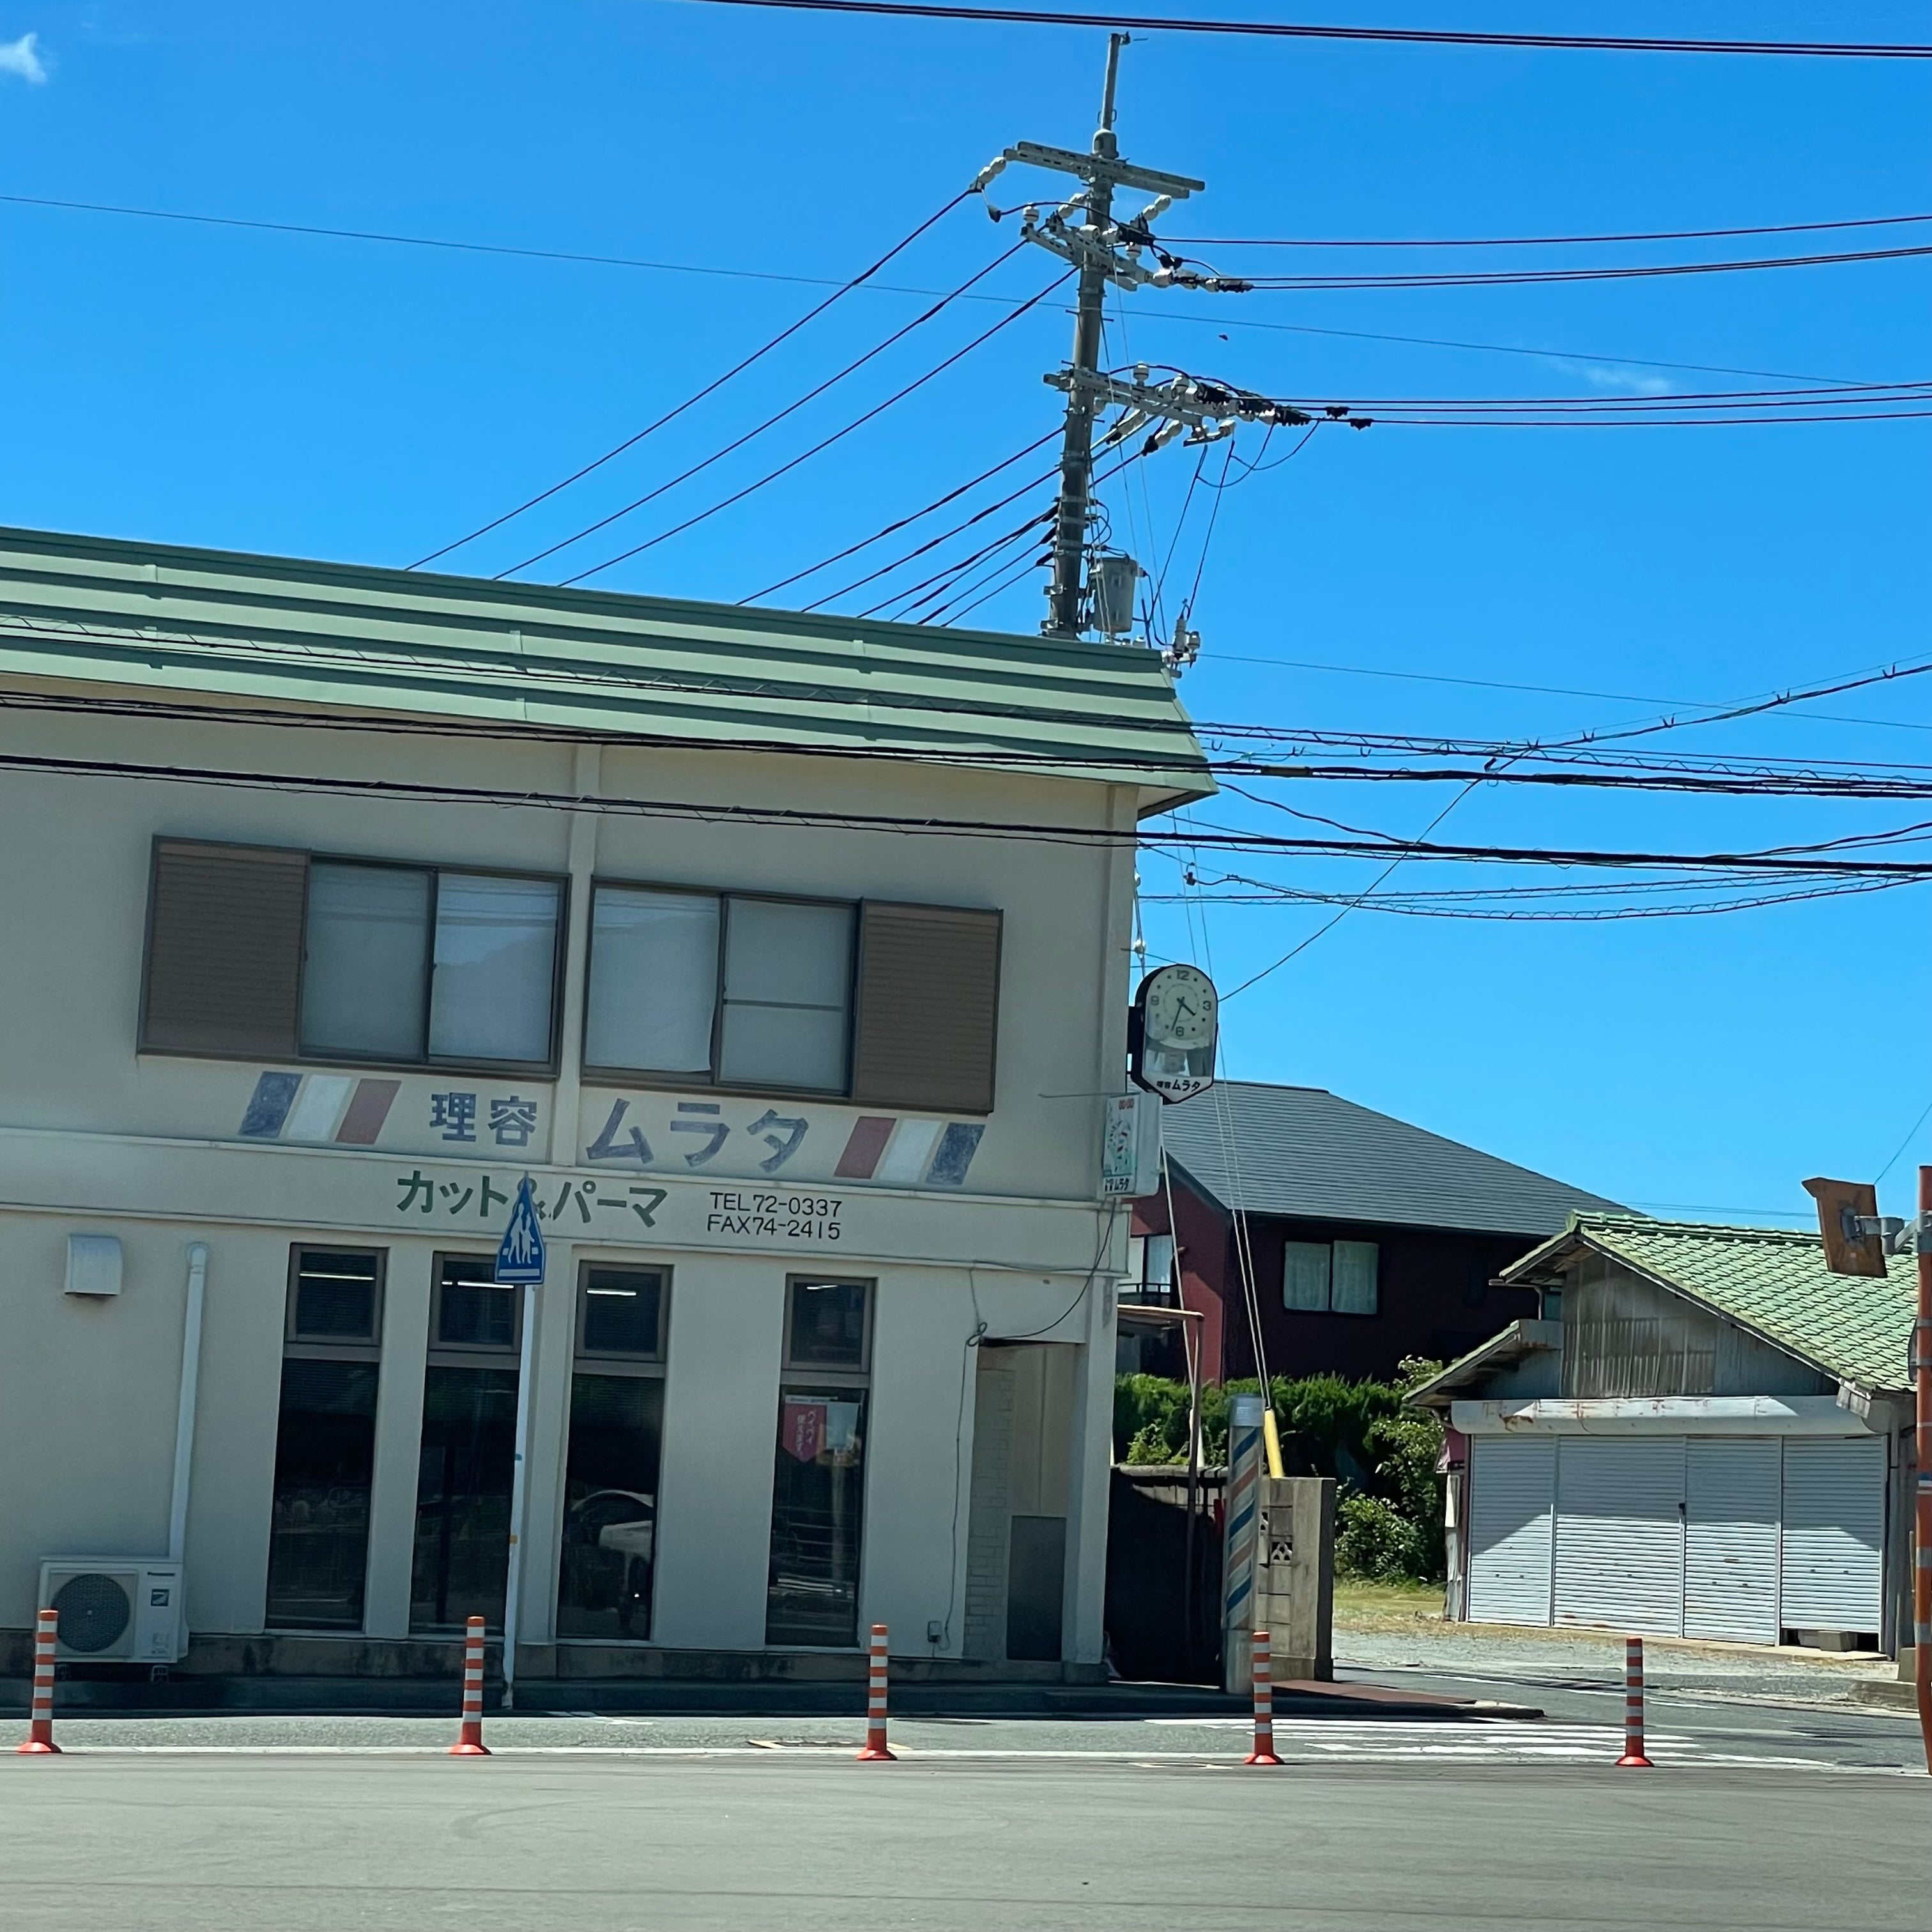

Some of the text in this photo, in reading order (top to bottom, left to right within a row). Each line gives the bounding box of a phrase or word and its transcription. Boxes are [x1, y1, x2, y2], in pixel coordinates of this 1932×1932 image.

[1177, 970, 1190, 980] 12
[1151, 997, 1160, 1006] 9
[1202, 1000, 1211, 1011] 3
[1176, 1026, 1184, 1036] 6
[429, 1092, 809, 1172] 理容 ムラタ
